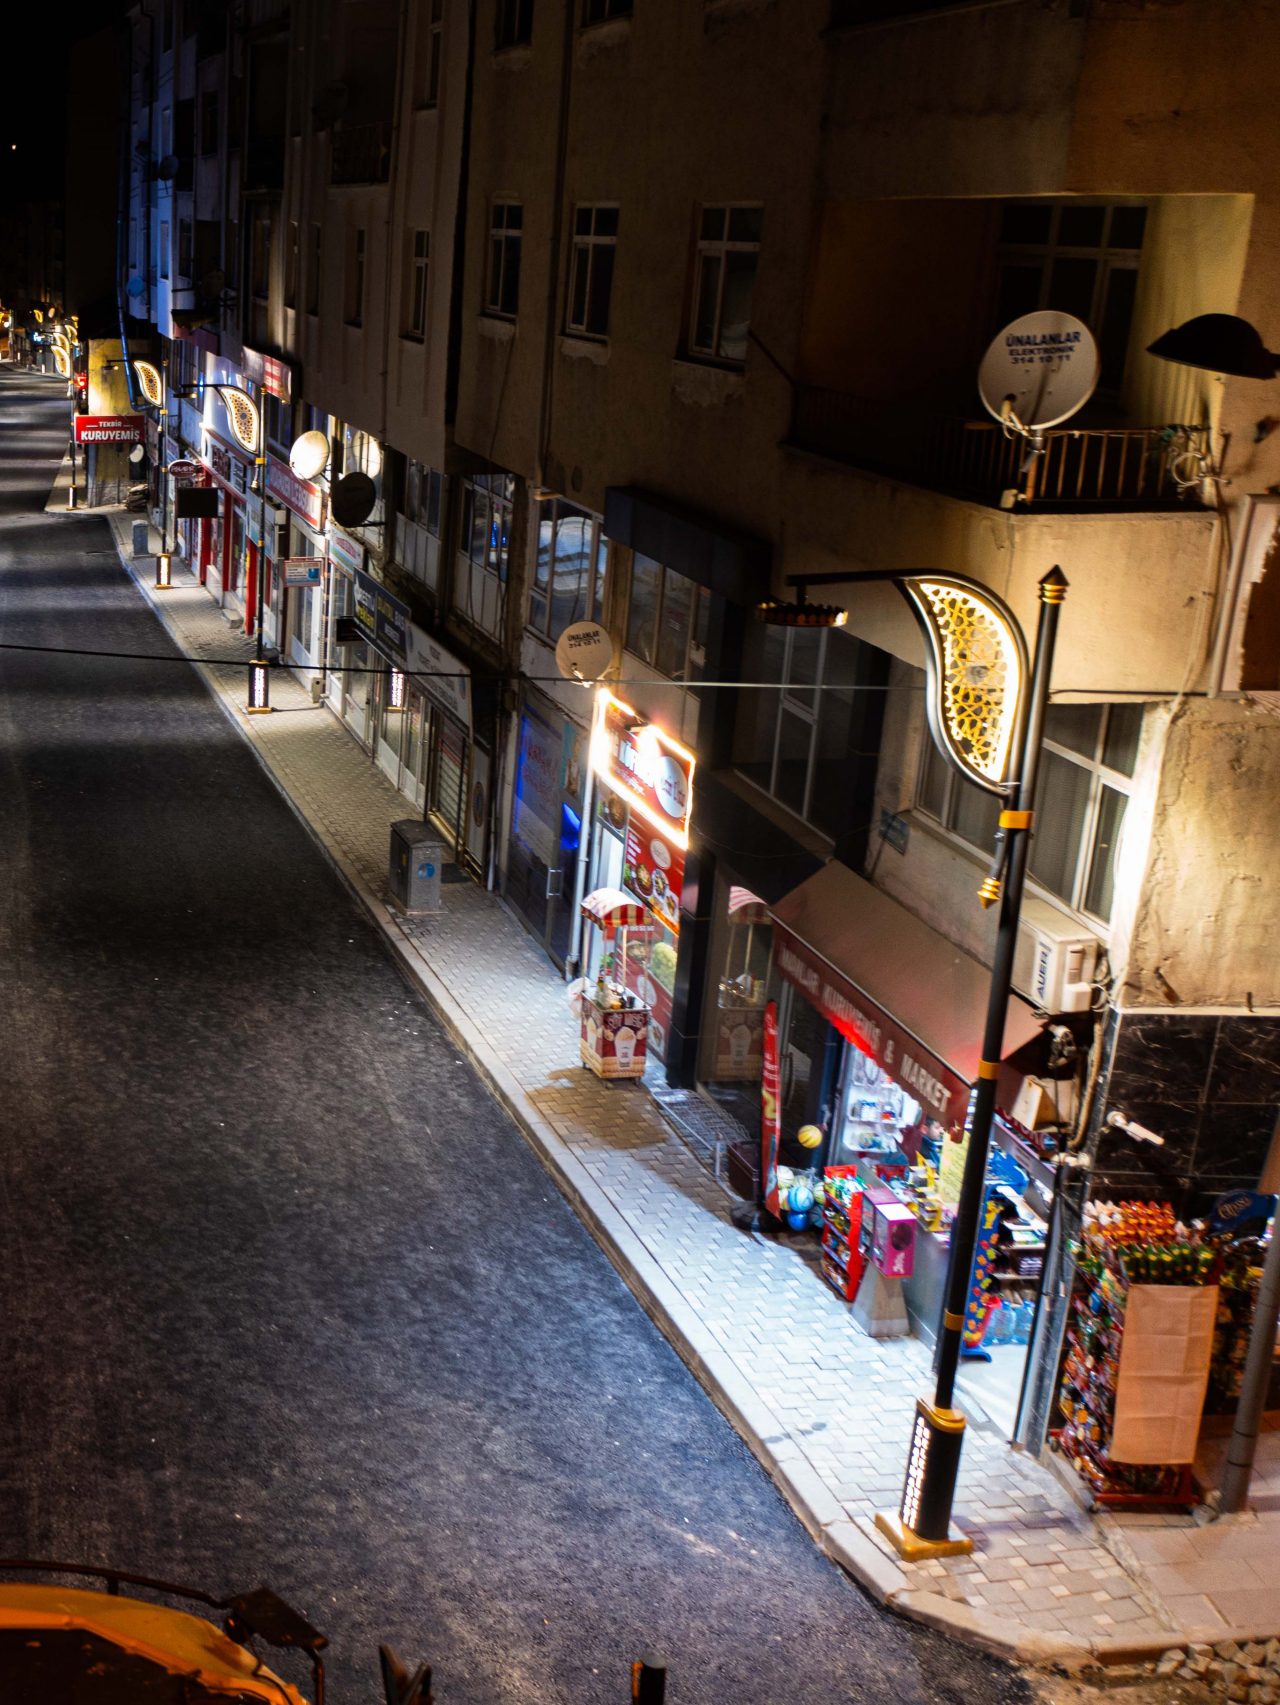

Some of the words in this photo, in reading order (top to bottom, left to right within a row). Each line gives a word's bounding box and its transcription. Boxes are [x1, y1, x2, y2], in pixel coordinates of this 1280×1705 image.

[1006, 333, 1081, 346] ÜNALANLAR
[99, 420, 122, 428] TEKBİR
[80, 428, 140, 442] KURUYEMİŞ
[884, 1040, 894, 1064] &
[900, 1054, 952, 1112] MARKET
